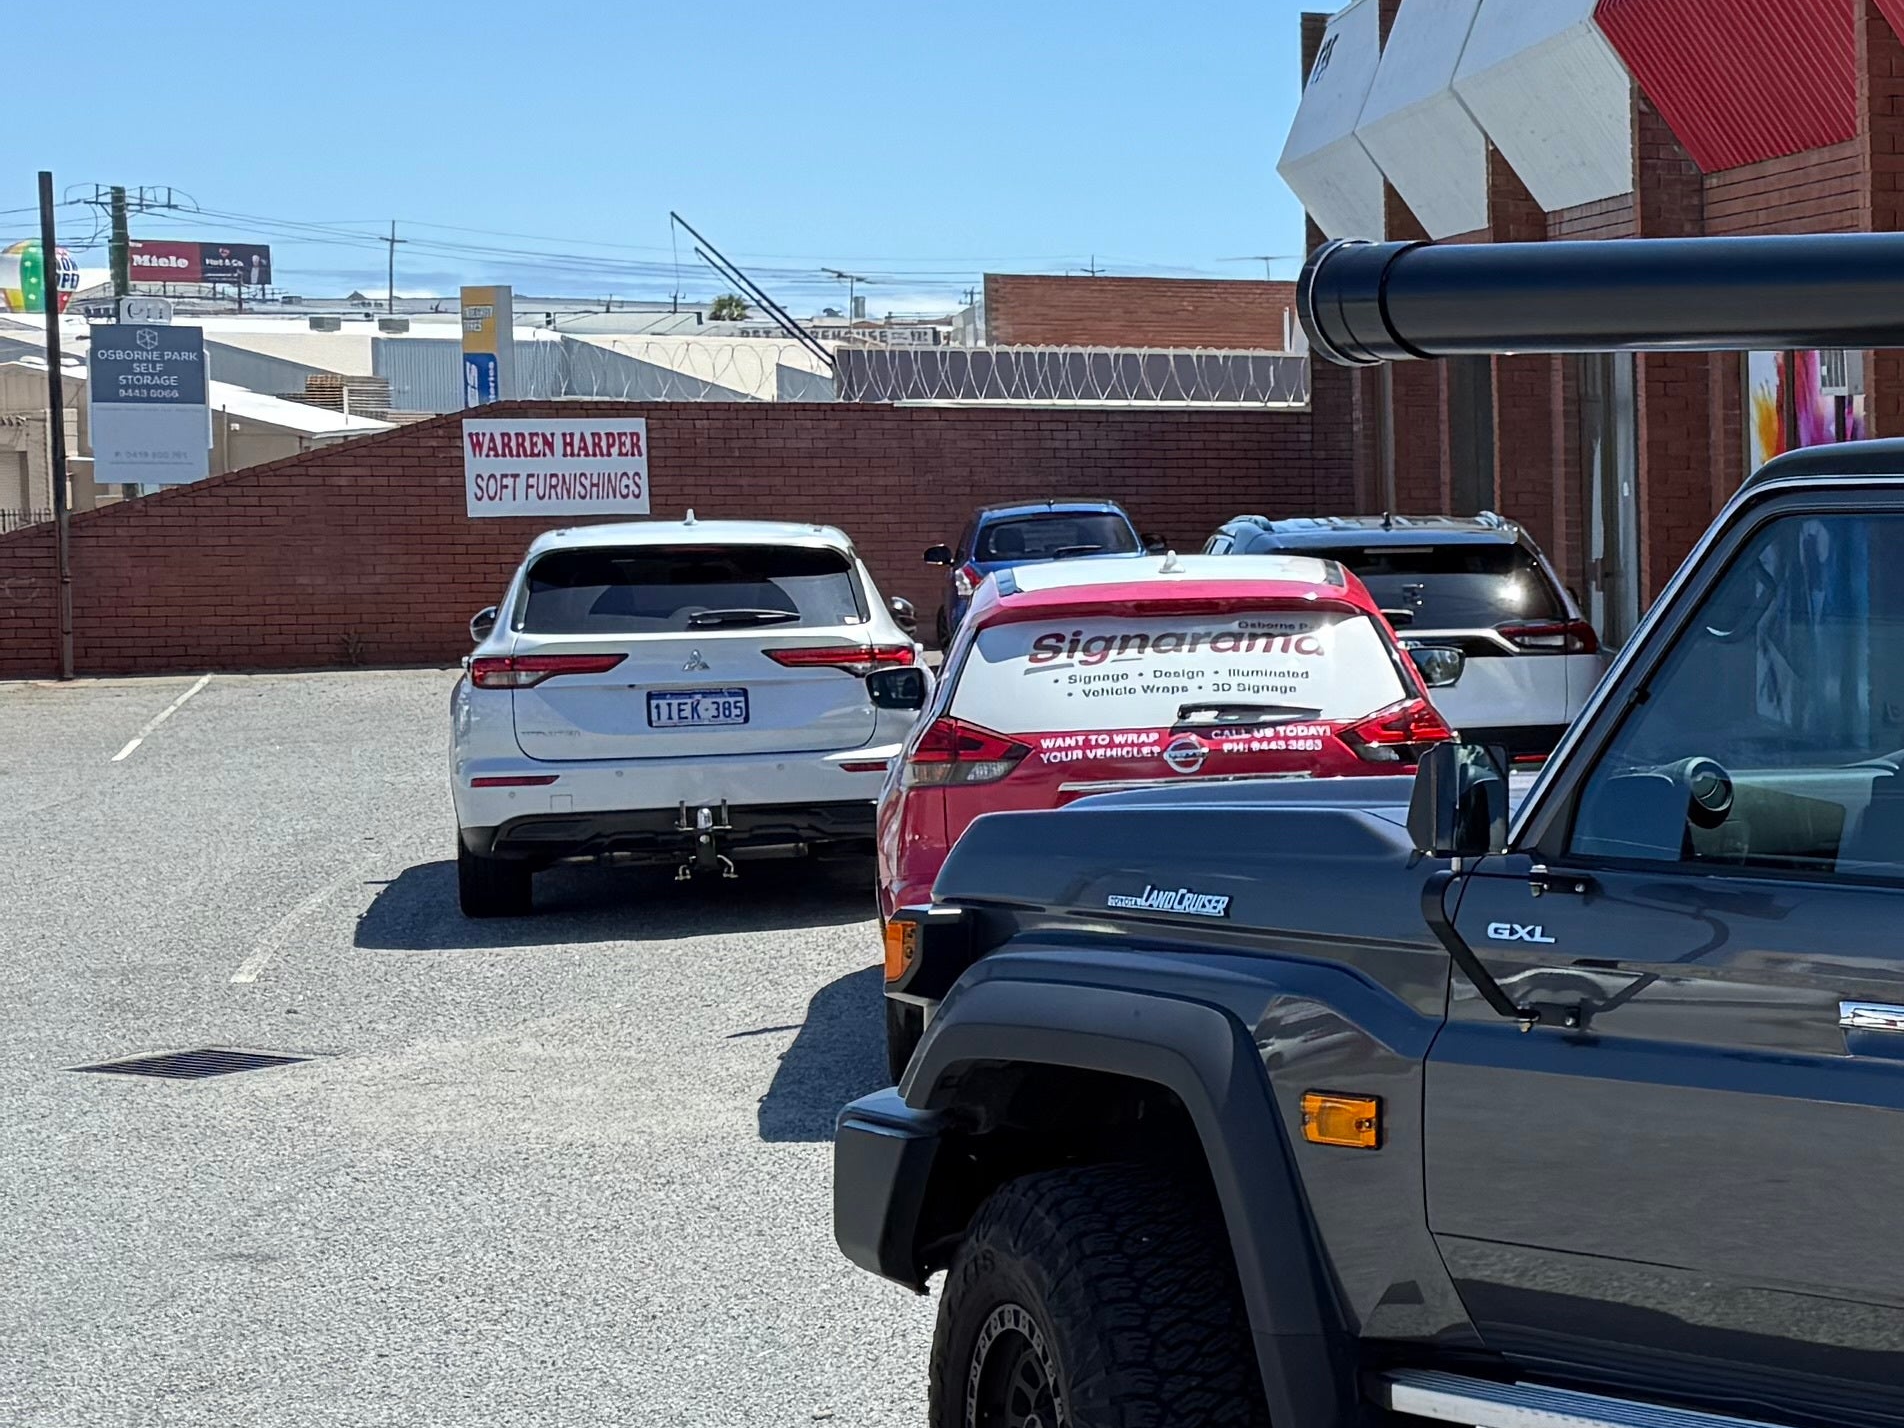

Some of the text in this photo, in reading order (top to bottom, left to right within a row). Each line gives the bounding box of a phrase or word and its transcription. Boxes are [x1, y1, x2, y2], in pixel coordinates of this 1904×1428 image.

[781, 329, 888, 342] WREHOUSE
[98, 349, 199, 362] OSBORNE PARK
[132, 362, 164, 373] SELF
[119, 375, 178, 386] STORAGE
[468, 431, 643, 459] WARREN HARPER
[474, 471, 642, 502] SOFT FURNISHINGS
[1028, 628, 1325, 665] Signarama
[1068, 667, 1309, 685] Signage Design Illuminated
[1082, 683, 1297, 698] Vehicle Wraps 3D Signage
[1040, 732, 1159, 749] WANT TO WRAP
[1211, 729, 1251, 740] CALL
[1276, 725, 1331, 737] TODAY!
[1040, 749, 1083, 763] YOUR
[1086, 745, 1161, 760] VEHICLE?
[1487, 922, 1557, 944] GXL
